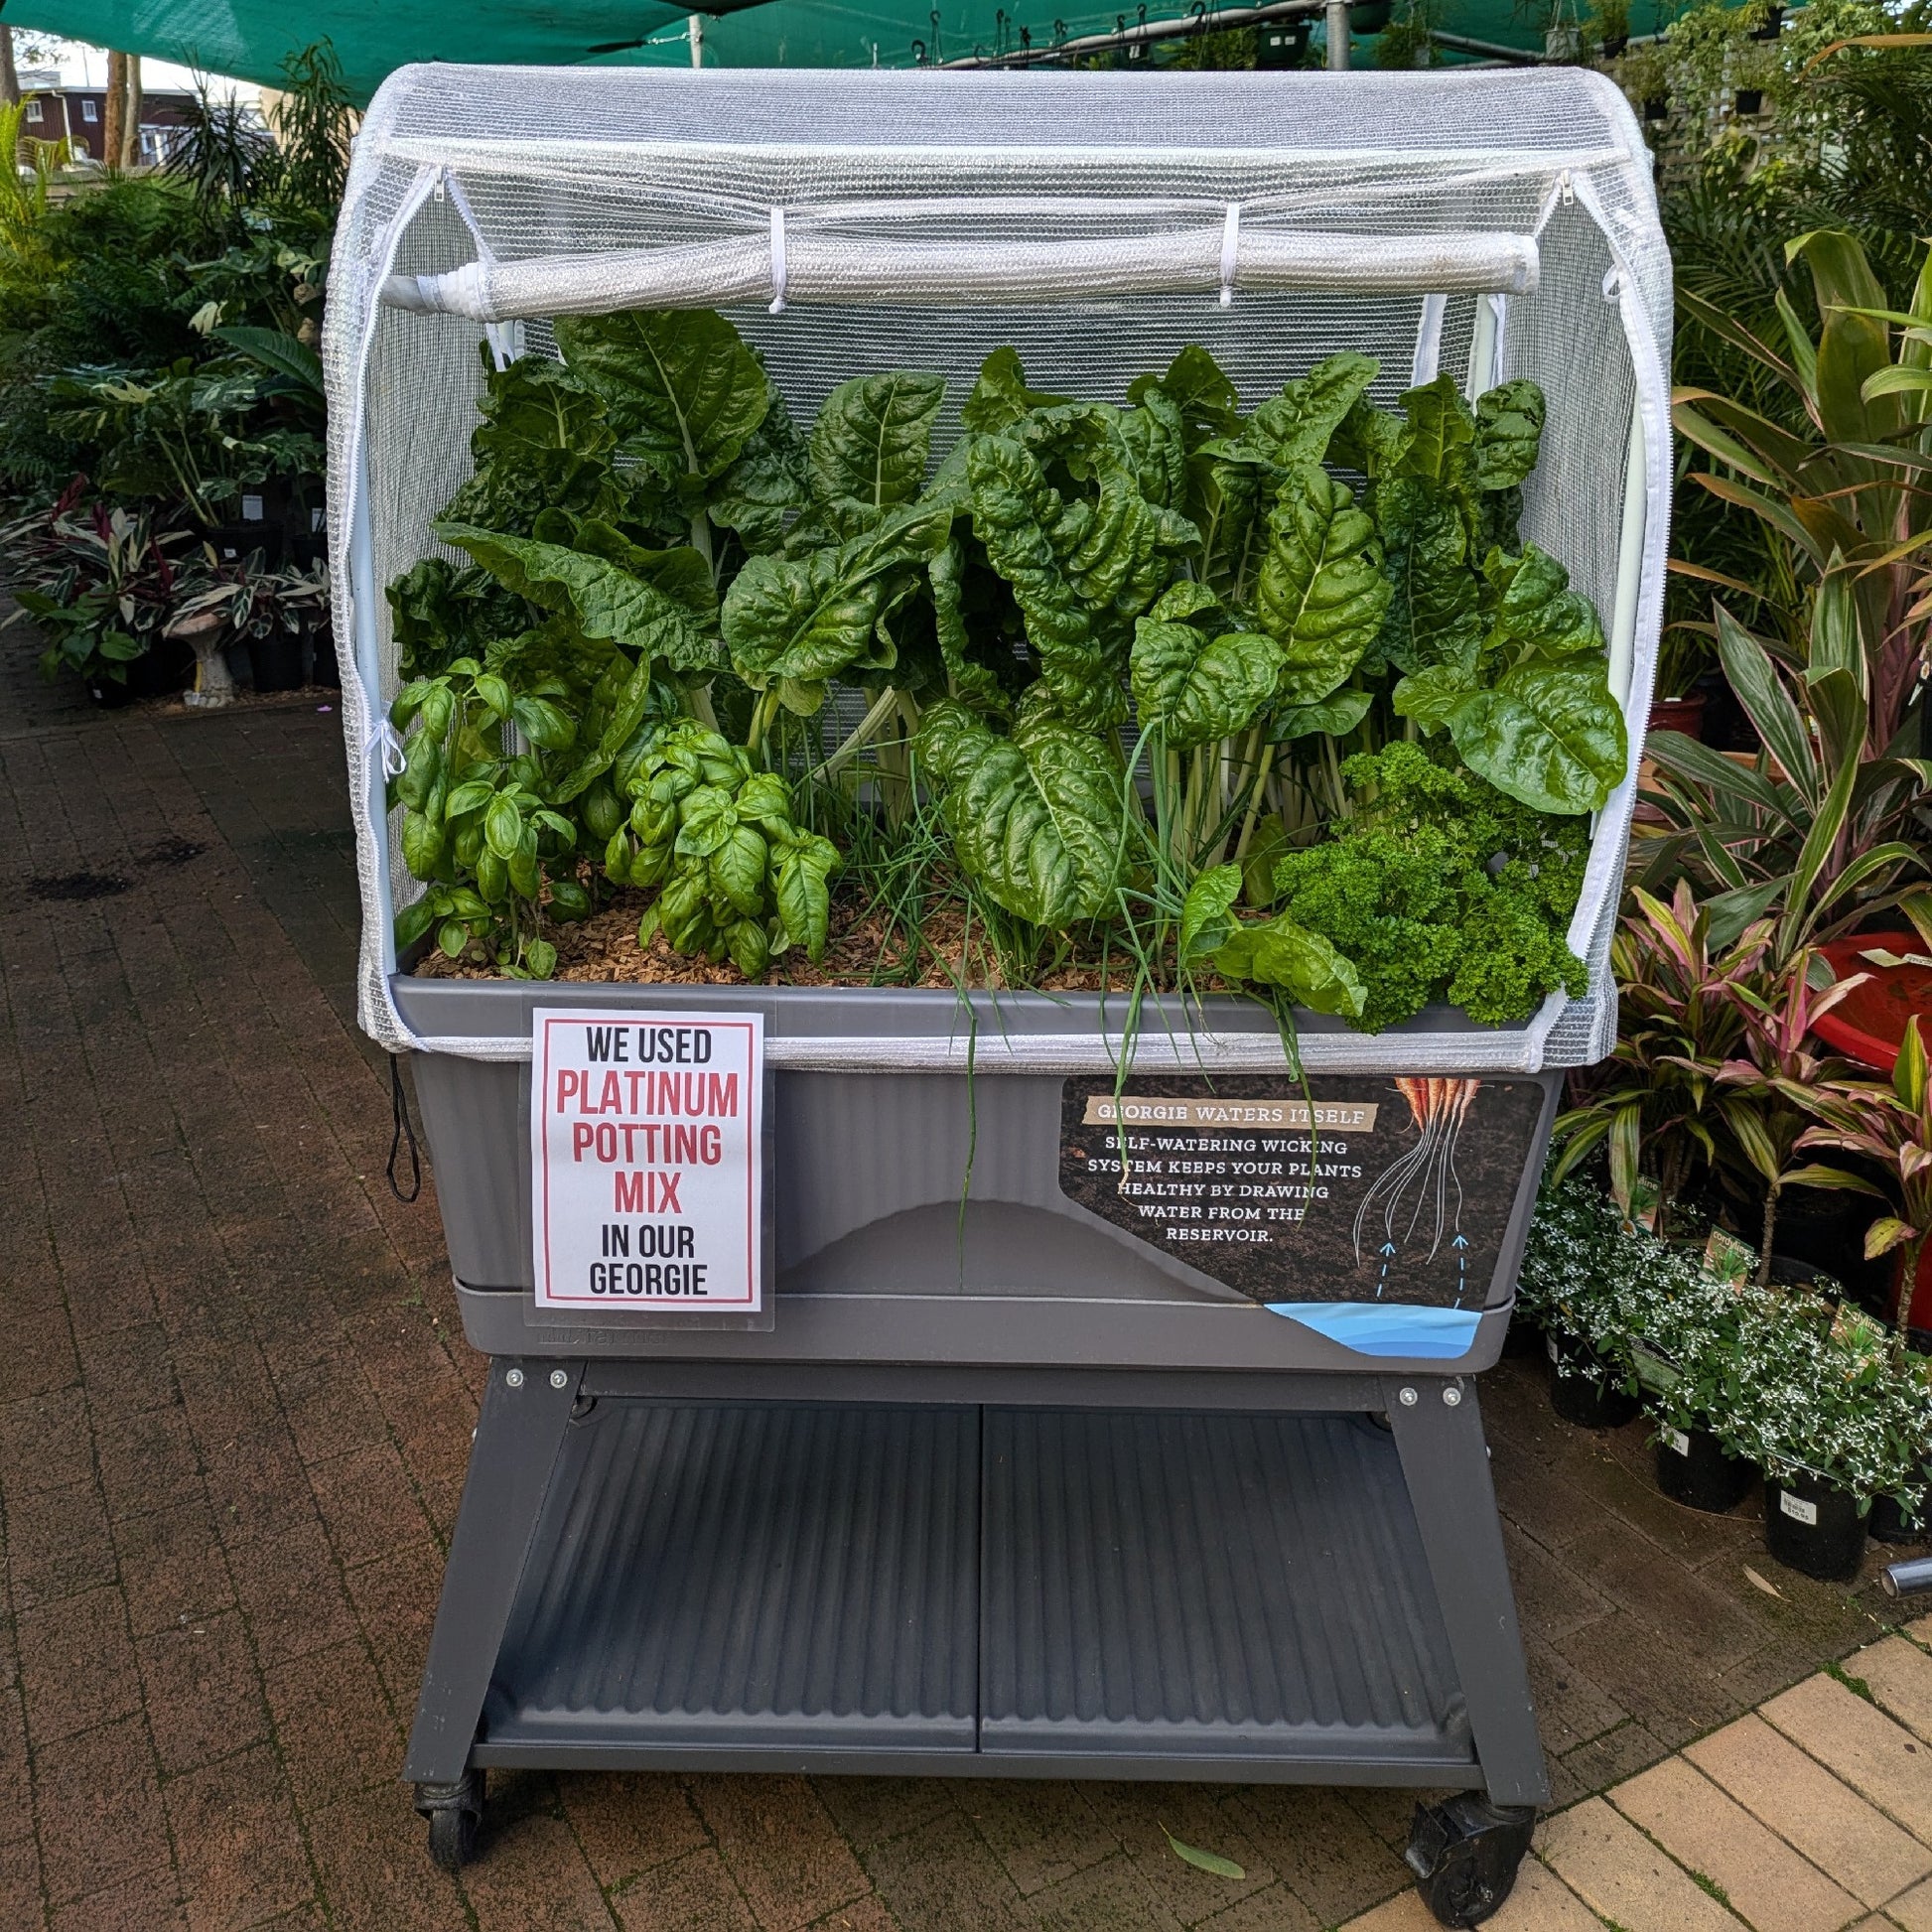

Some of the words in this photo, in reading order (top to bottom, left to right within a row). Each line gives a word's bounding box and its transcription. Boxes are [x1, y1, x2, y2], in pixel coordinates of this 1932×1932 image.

[586, 1027, 629, 1062] WE
[638, 1028, 712, 1063] USED
[556, 1069, 738, 1117] PLATINUM
[1195, 1106, 1283, 1123] WATERS
[1290, 1109, 1365, 1125] ITSELF
[573, 1122, 722, 1165] POTTING
[1261, 1139, 1348, 1155] WICKNG
[1088, 1159, 1163, 1173] SYSTEM
[1168, 1161, 1226, 1174] KEEPS
[1231, 1162, 1283, 1176] YOUR
[1289, 1163, 1362, 1179] PLANTS
[614, 1171, 682, 1213] MIX
[1117, 1182, 1206, 1196] HEALTHY
[1210, 1184, 1234, 1197] BY
[1239, 1184, 1329, 1198] DRAWING
[1139, 1205, 1202, 1218] WATER
[1208, 1206, 1261, 1220] FROM
[1267, 1207, 1306, 1221] THE
[602, 1224, 628, 1258] IN
[638, 1225, 695, 1259] OUR
[1167, 1227, 1273, 1242] RESERVOIR.
[590, 1262, 708, 1296] GEORGIE
